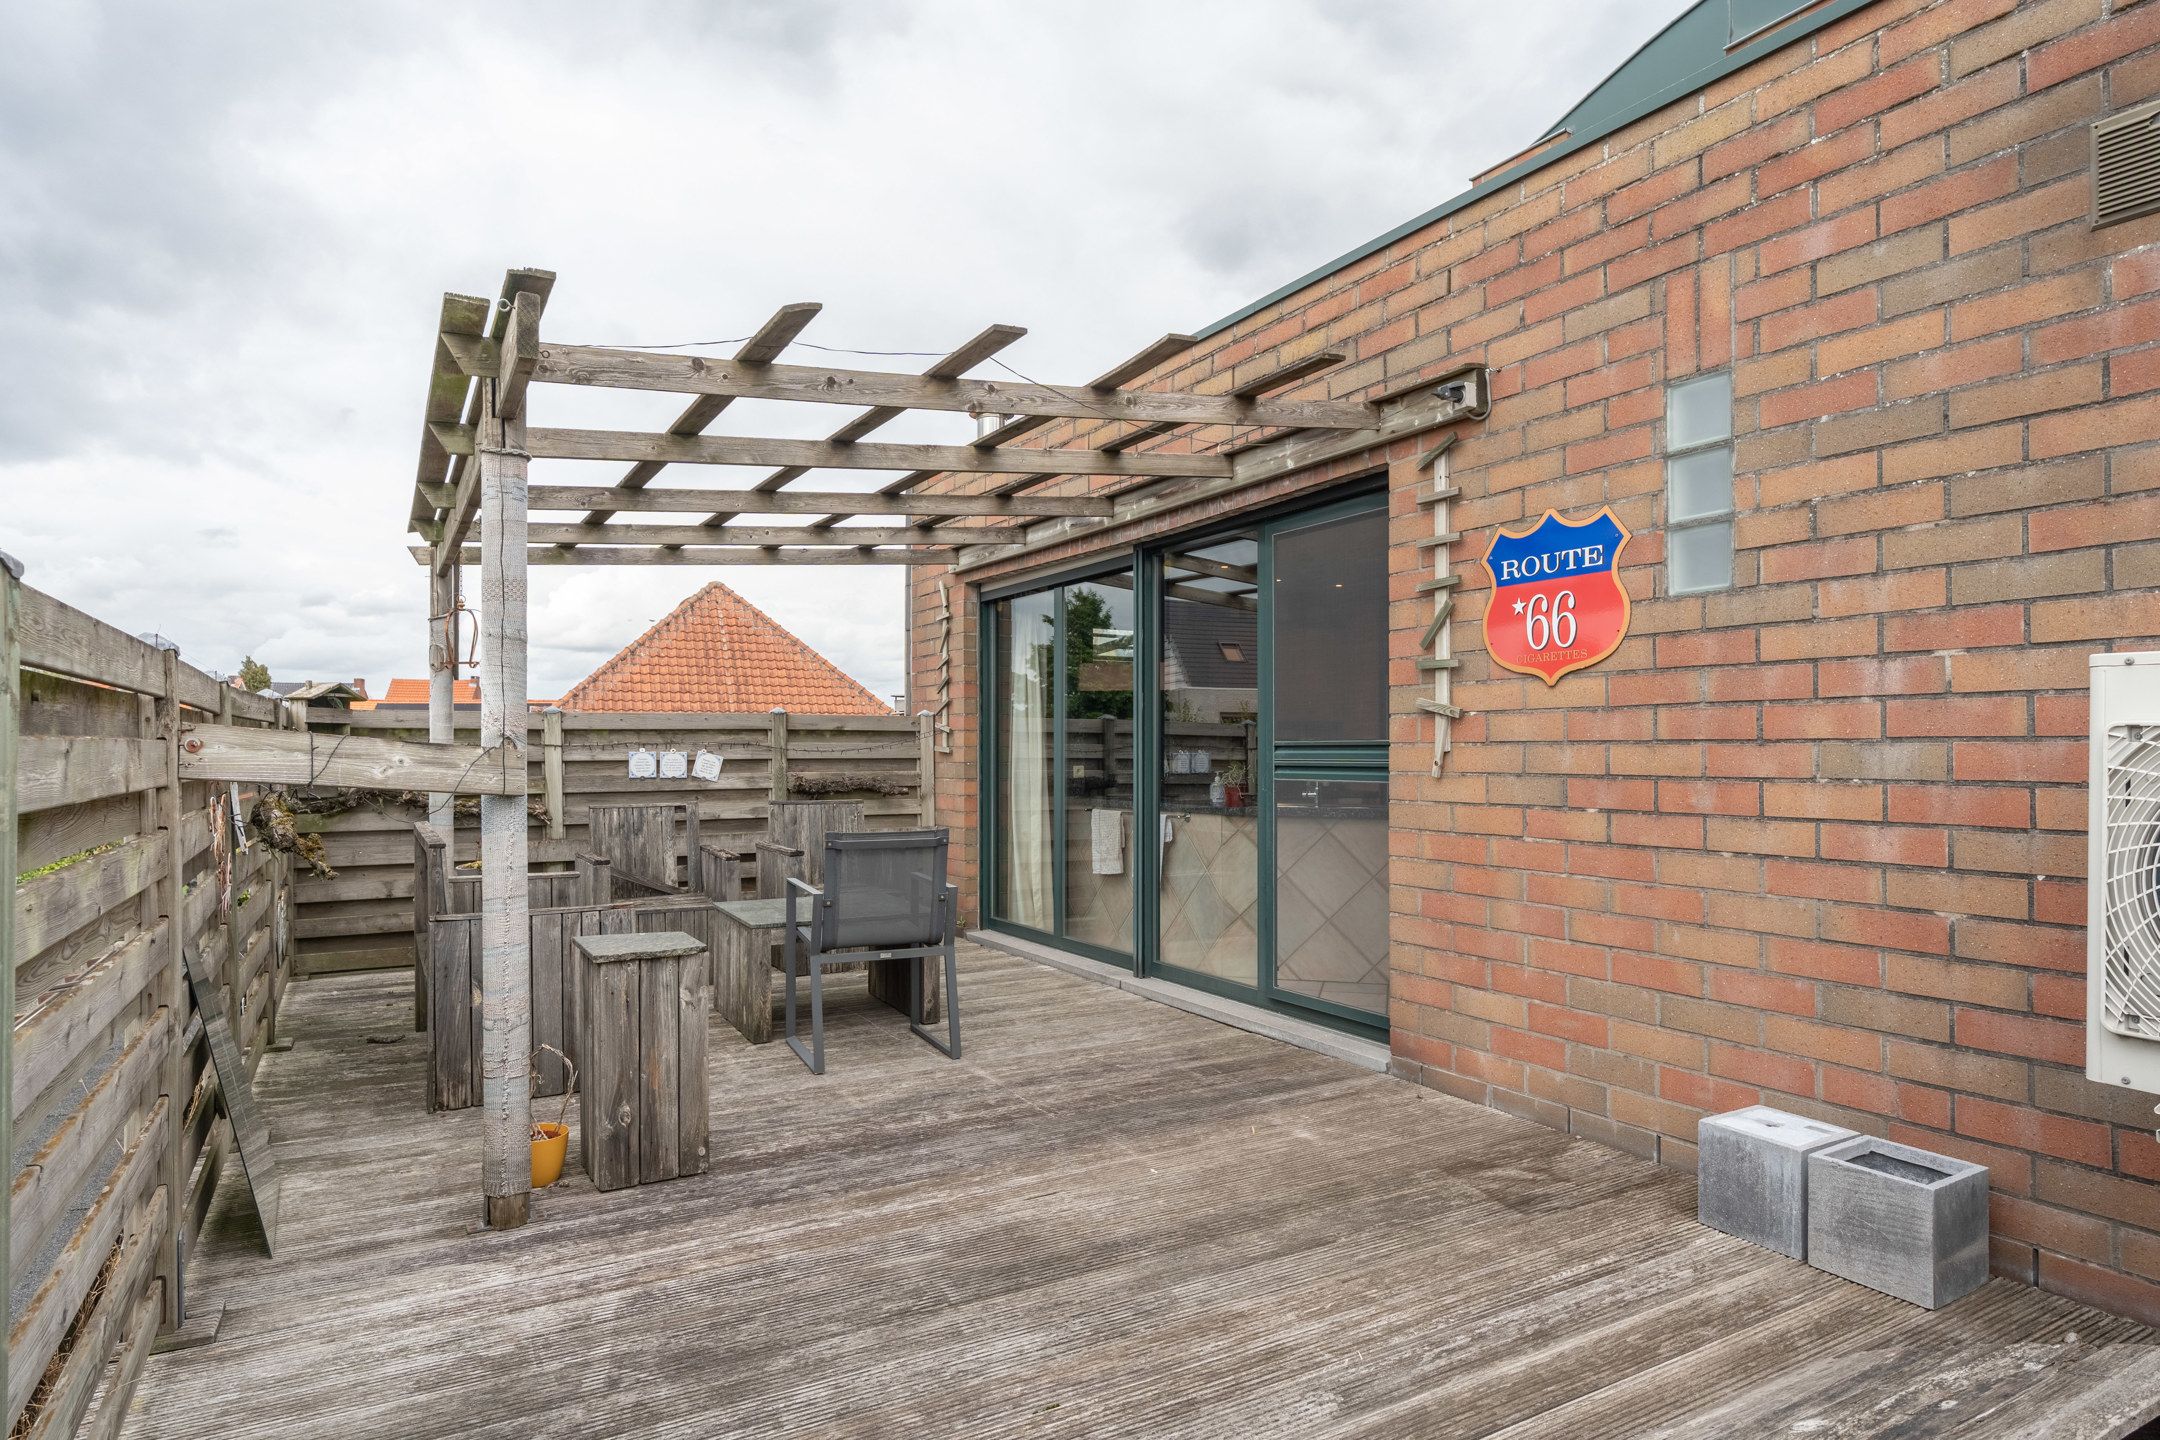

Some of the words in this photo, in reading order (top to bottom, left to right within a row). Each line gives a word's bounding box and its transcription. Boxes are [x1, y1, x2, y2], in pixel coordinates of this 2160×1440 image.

[1500, 544, 1605, 581] ROUTE
[1526, 590, 1577, 651] 66
[1516, 649, 1588, 664] CIGARETTES
